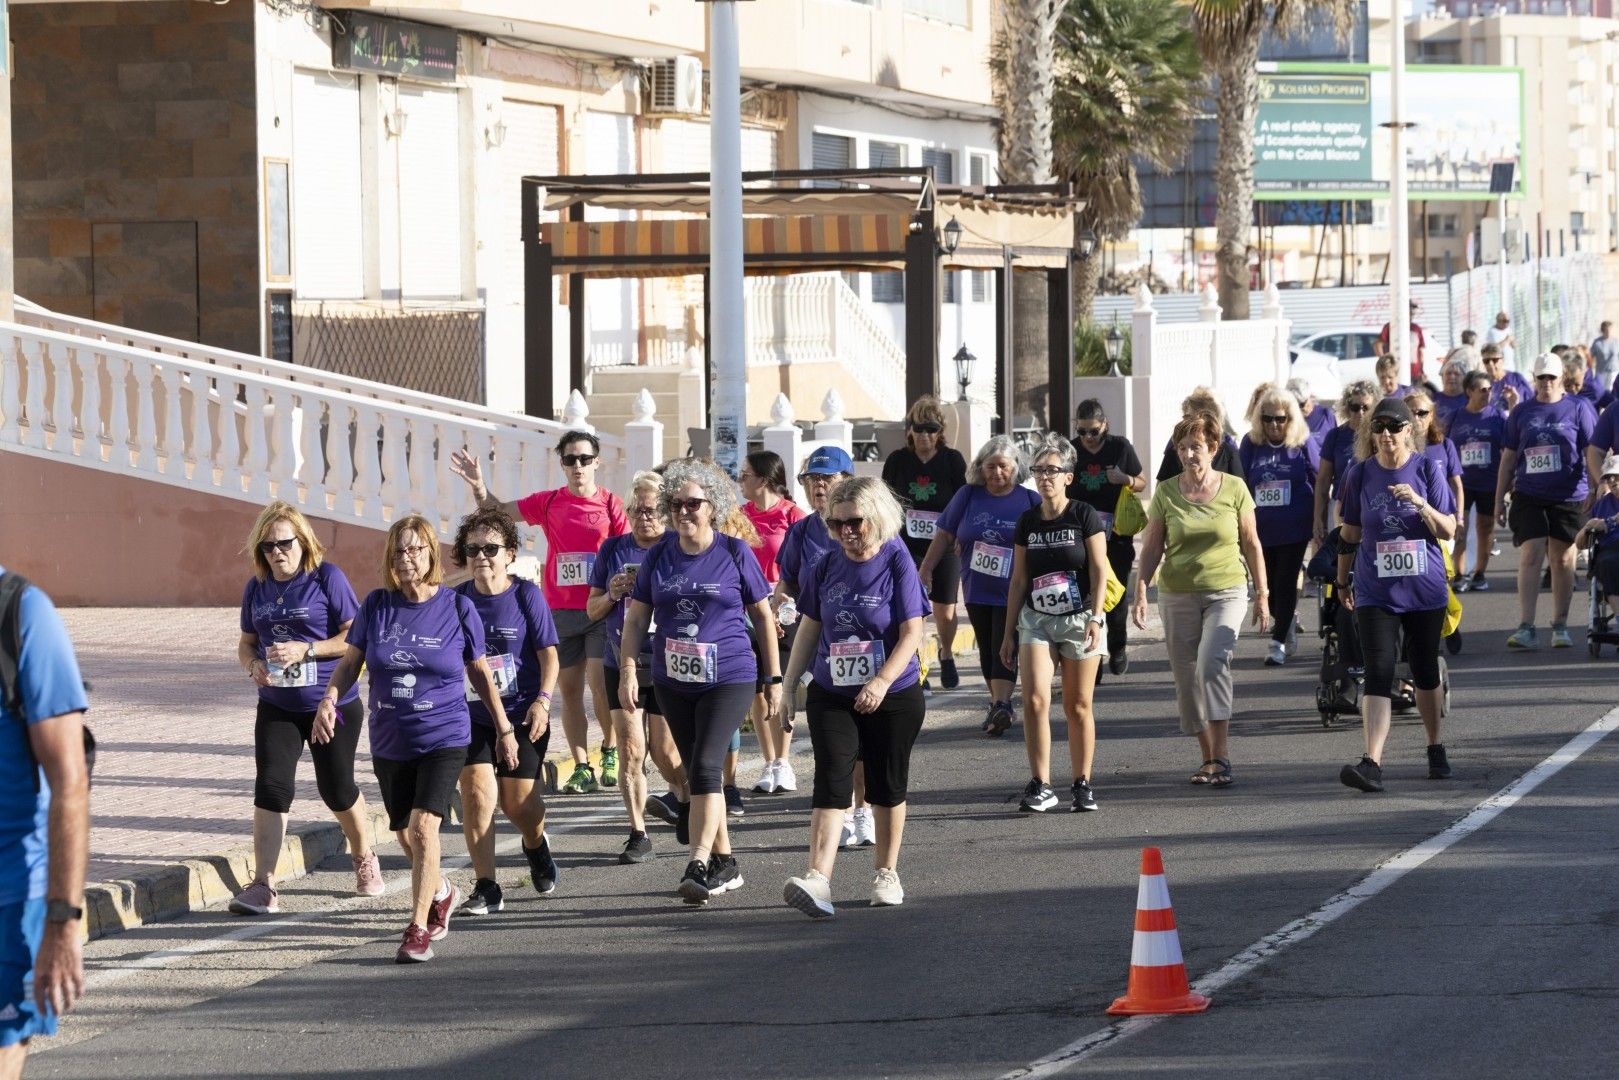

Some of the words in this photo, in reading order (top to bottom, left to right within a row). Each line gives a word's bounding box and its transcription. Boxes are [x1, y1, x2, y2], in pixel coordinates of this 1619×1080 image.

[1321, 83, 1364, 95] PROPERTY
[1260, 120, 1269, 132] A
[1270, 120, 1290, 132] real
[1291, 120, 1322, 132] estate
[1323, 122, 1361, 135] agency
[1262, 150, 1276, 160] on
[1277, 148, 1294, 160] the
[1295, 148, 1324, 160] Costa
[1465, 450, 1483, 461] 314
[1530, 455, 1551, 469] 384
[1259, 489, 1280, 502] 368
[910, 519, 934, 534] 395
[1036, 529, 1075, 544] KAIZEN
[975, 552, 1000, 571] 306
[1383, 552, 1414, 571] 300
[562, 562, 582, 580] 391
[1036, 591, 1070, 608] 134
[670, 653, 702, 676] 356
[835, 655, 870, 678] 373
